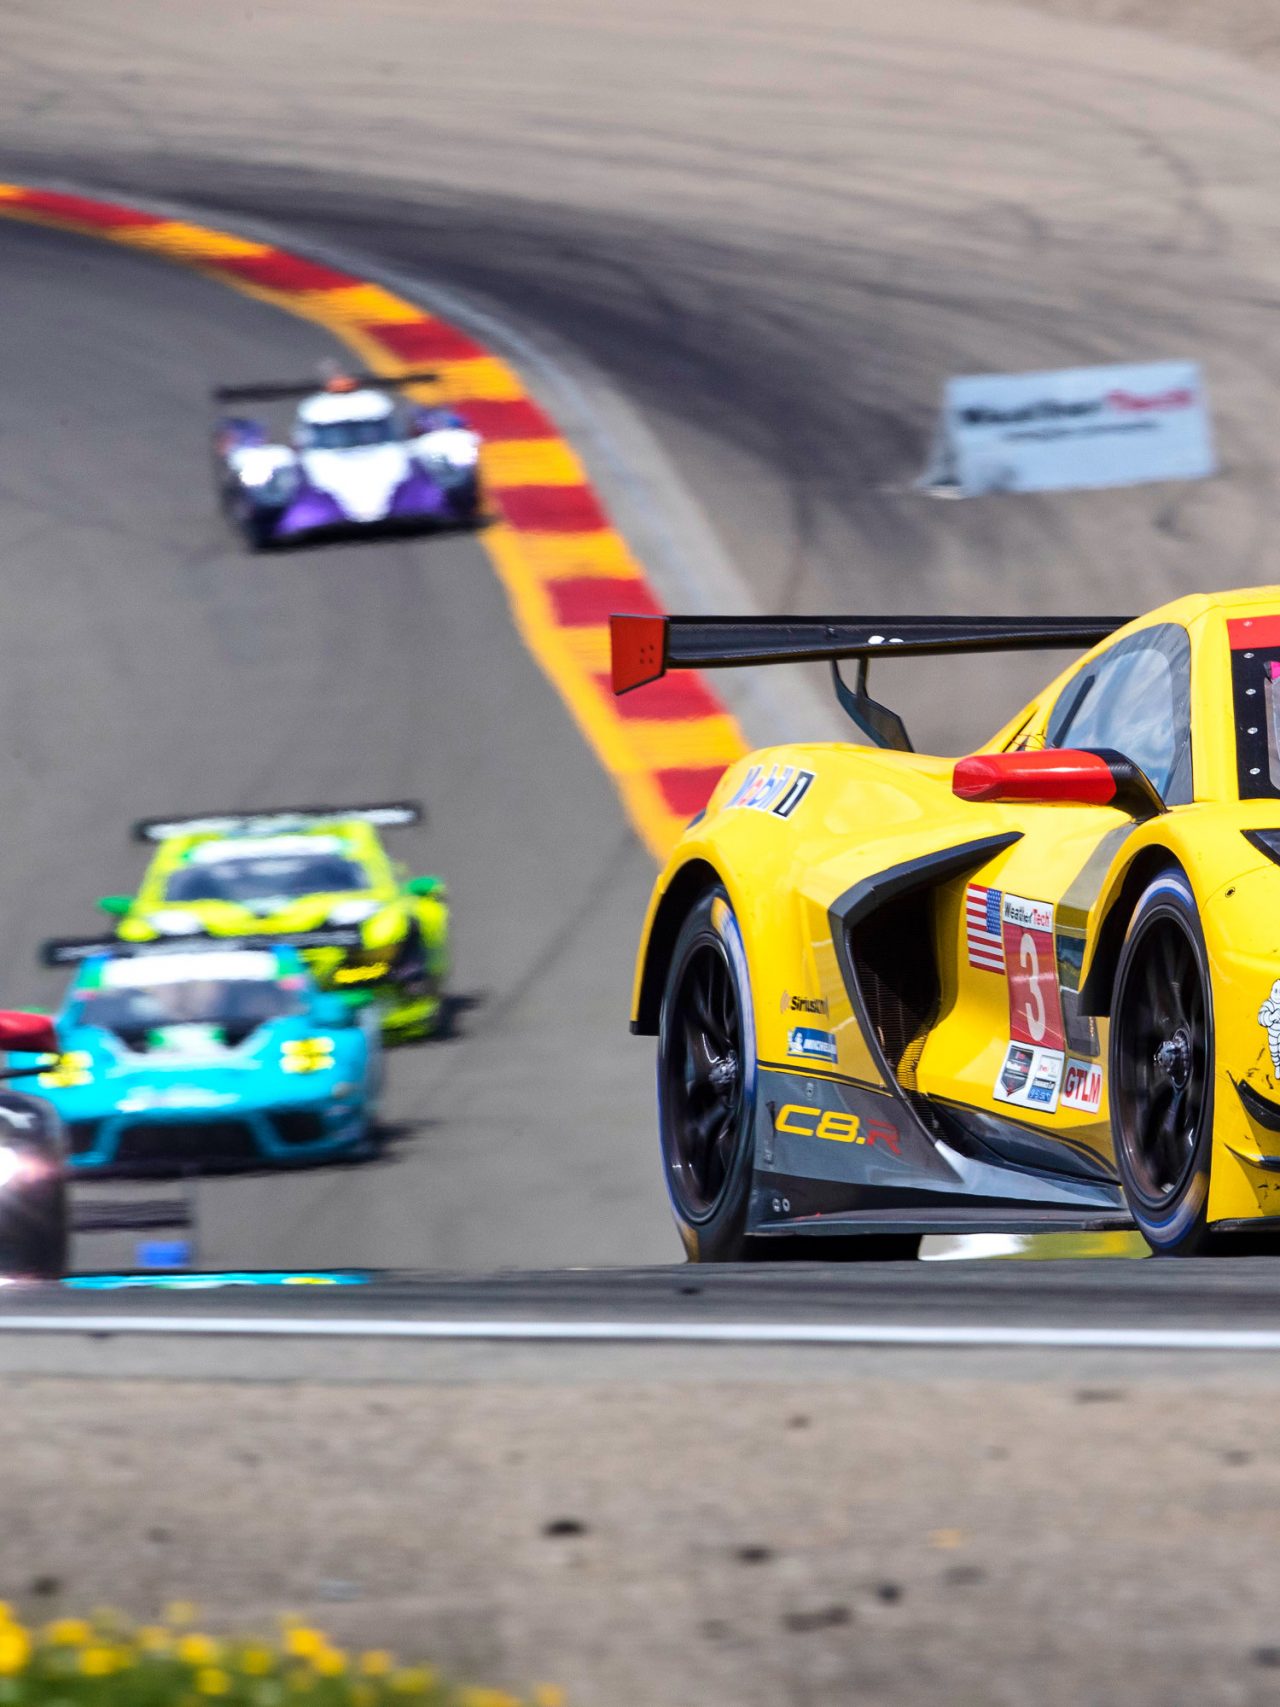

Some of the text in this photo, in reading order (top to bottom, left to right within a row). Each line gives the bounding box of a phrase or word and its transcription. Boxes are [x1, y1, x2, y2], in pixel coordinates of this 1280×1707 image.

[1020, 933, 1046, 1042] 3
[1064, 1066, 1102, 1105] GTLM
[774, 1103, 902, 1155] C8.R
